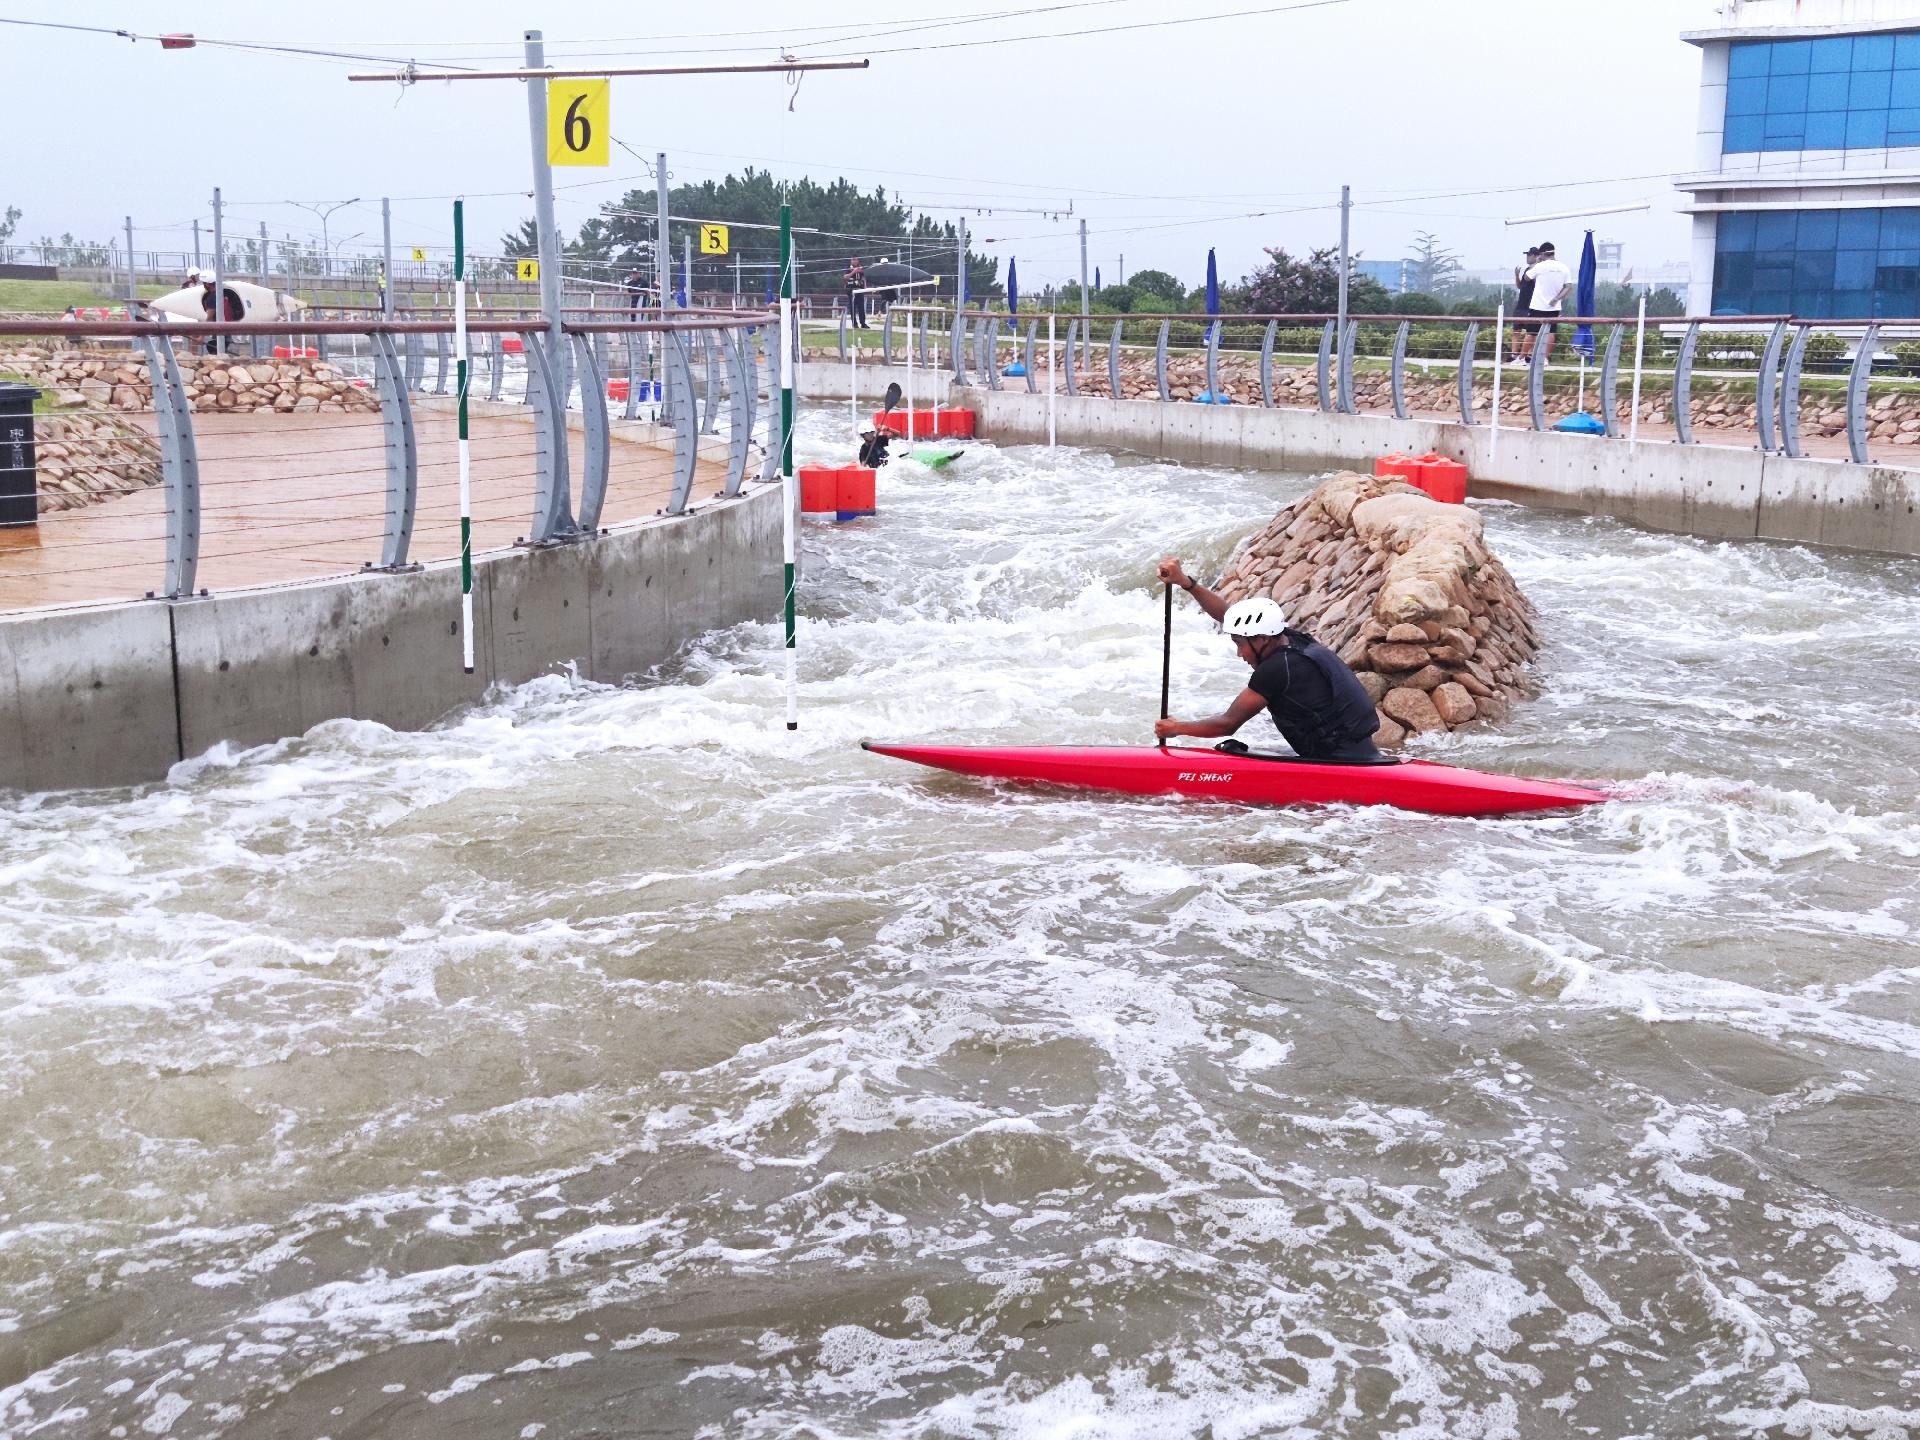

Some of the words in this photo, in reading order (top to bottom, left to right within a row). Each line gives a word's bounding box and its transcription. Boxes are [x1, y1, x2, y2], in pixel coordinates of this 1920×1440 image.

[564, 93, 592, 152] 6
[709, 229, 720, 249] 5
[523, 263, 532, 278] 4
[1177, 772, 1197, 782] PEI
[1197, 772, 1233, 783] SHENG
